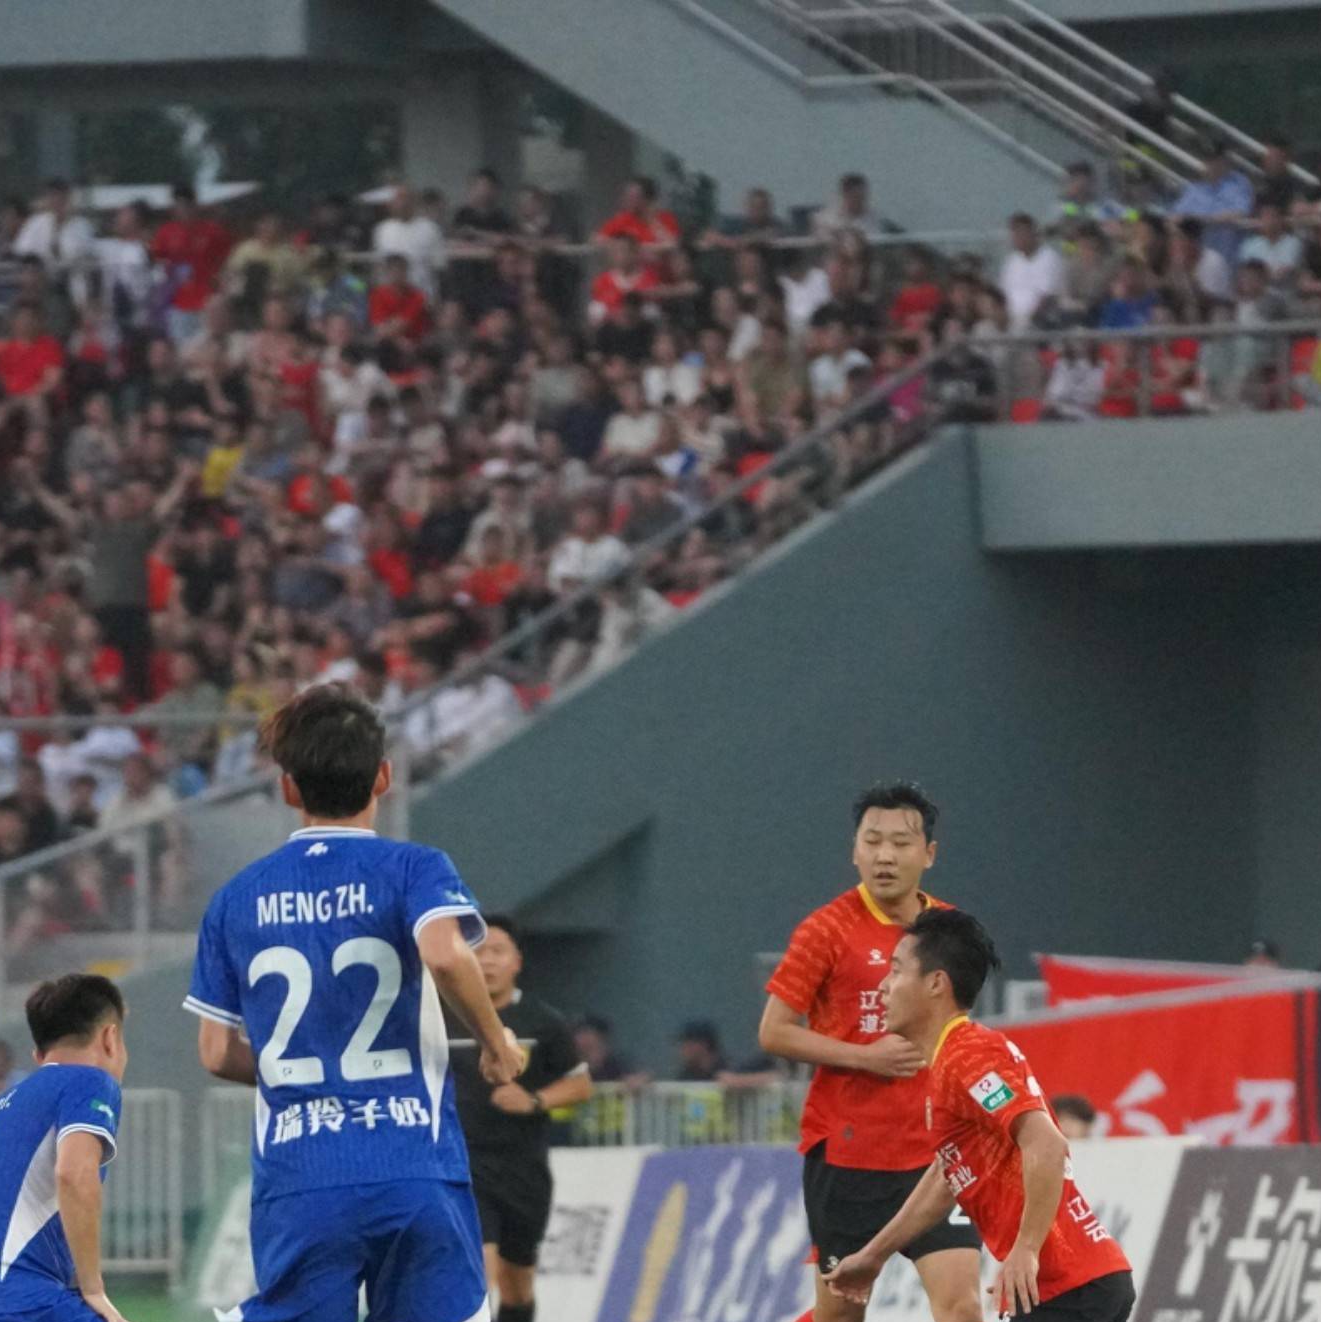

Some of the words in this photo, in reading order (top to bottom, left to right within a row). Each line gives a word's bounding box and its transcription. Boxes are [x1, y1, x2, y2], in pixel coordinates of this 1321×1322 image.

[257, 891, 332, 928] MENG
[336, 883, 374, 919] ZH.
[248, 936, 413, 1088] 22
